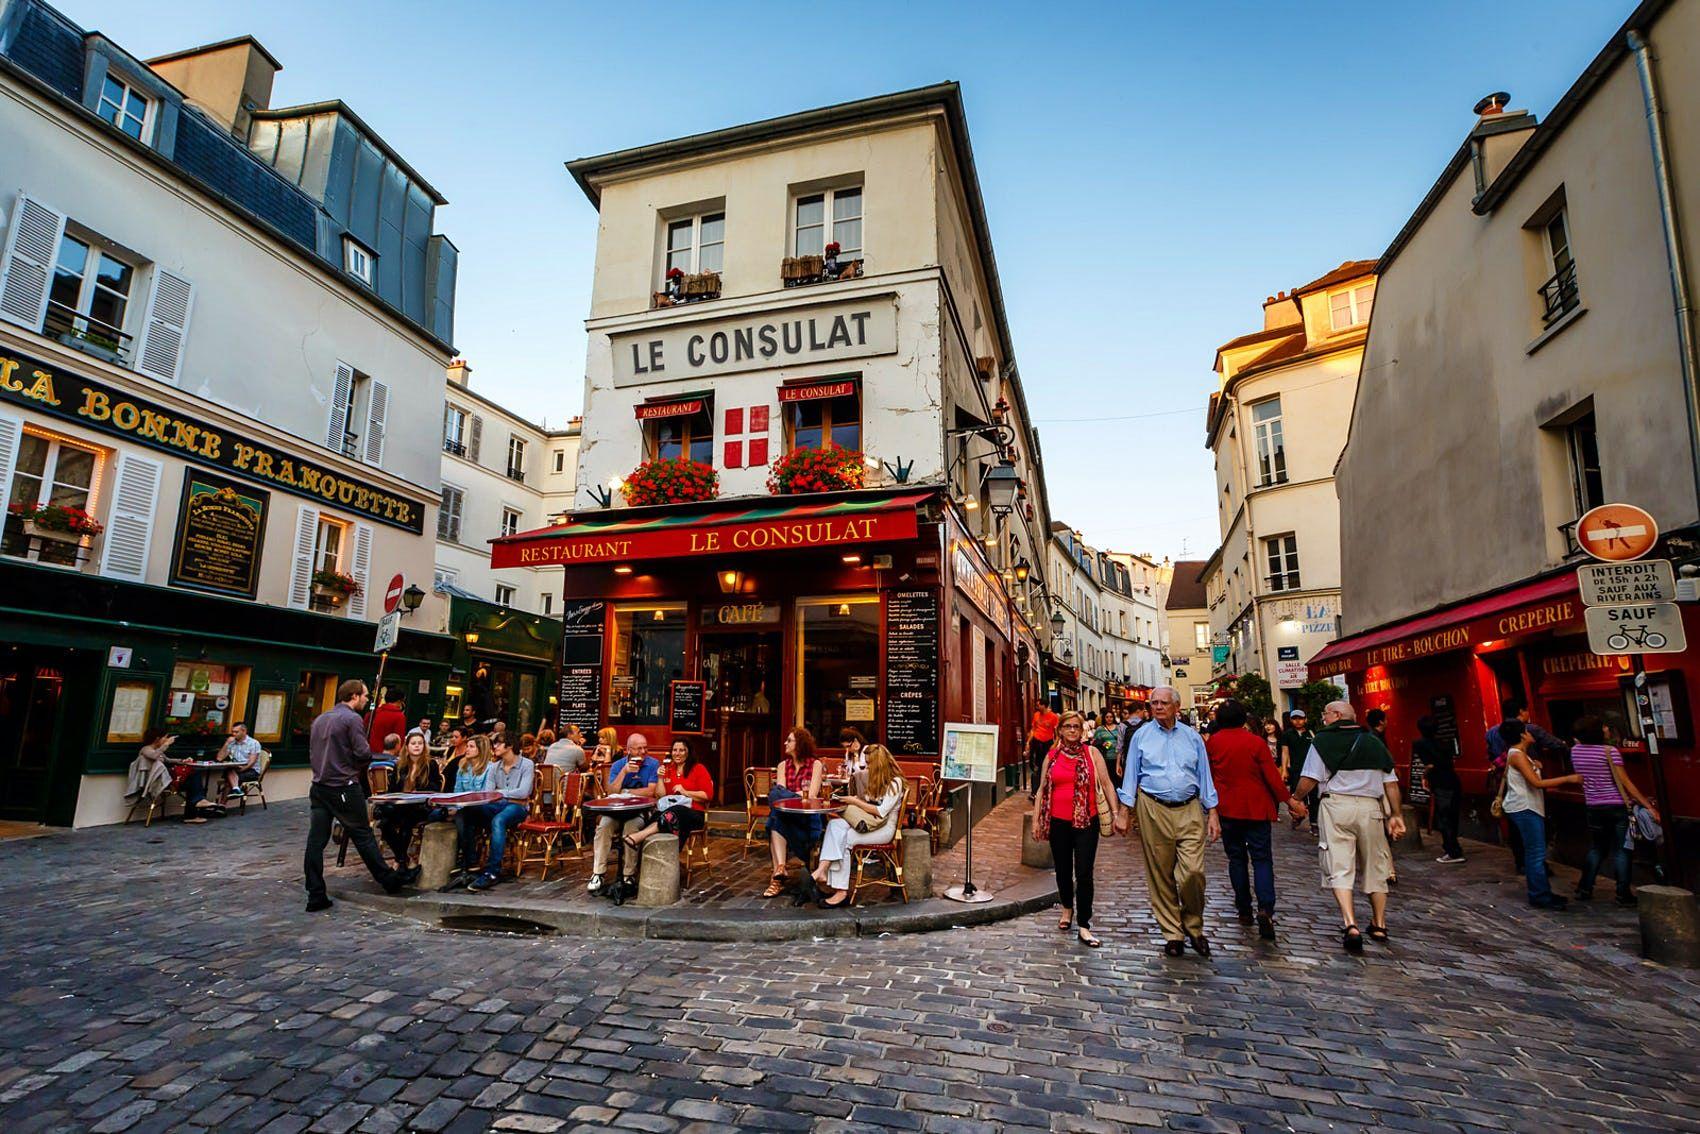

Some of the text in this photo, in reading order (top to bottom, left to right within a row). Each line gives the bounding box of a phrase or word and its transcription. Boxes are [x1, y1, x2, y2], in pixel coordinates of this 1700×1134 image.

[632, 311, 871, 375] LE CONSULAT
[784, 383, 847, 401] LE CONSULAT
[642, 402, 695, 419] RESTAURANT
[0, 356, 412, 523] LA BONNE FRANQUETTE
[520, 517, 878, 562] RESTAURANT LE CONSULAT
[1592, 563, 1657, 578] INTERDIT
[1609, 576, 1629, 585] 15h
[1645, 573, 1660, 583] 2h
[897, 591, 929, 599] OMELETTES
[1597, 591, 1662, 603] RIVERAINS
[1598, 583, 1657, 595] SAUF AUX
[717, 601, 764, 624] CAFÉ
[1499, 602, 1574, 635] CREPERIE
[1608, 607, 1657, 621] SAUF
[1367, 651, 1379, 666] LE
[1382, 643, 1405, 663] TIRE
[1413, 626, 1471, 655] BOUCHON
[1338, 658, 1352, 670] BAR
